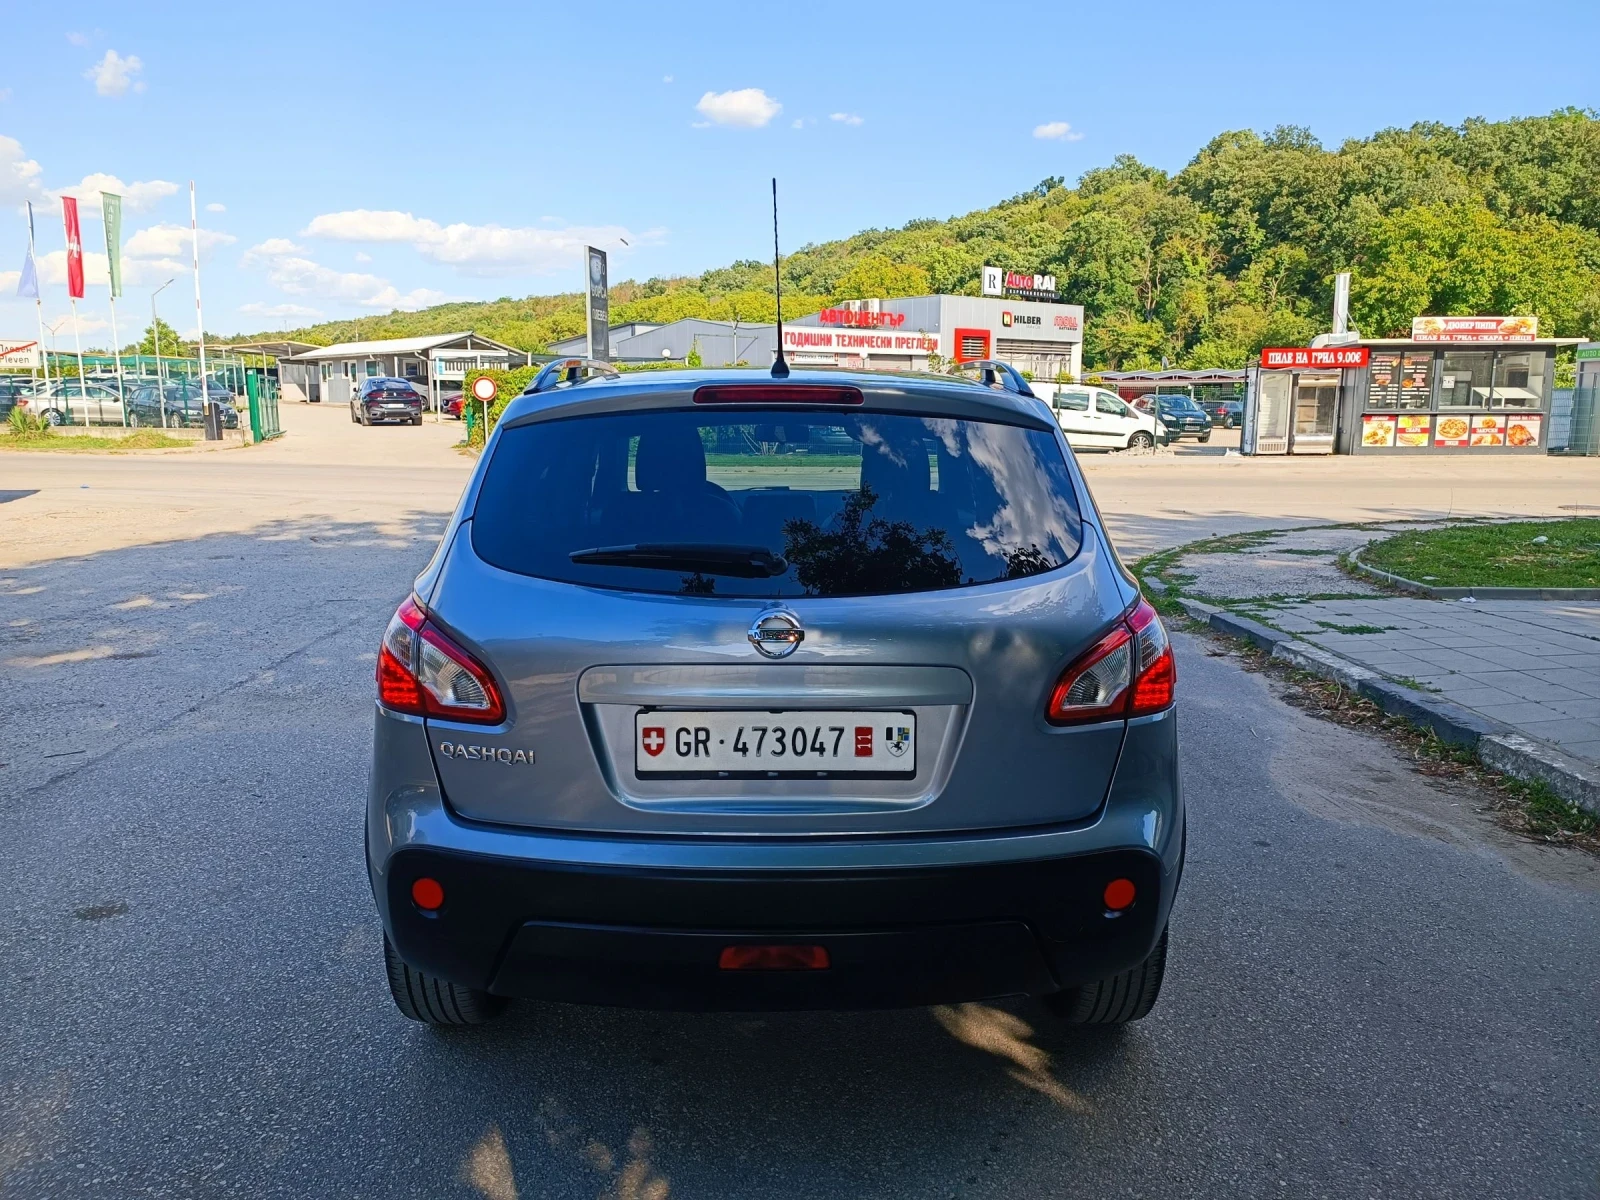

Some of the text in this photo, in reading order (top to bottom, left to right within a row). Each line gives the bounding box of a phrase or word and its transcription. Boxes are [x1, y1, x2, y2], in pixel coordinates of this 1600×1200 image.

[988, 273, 996, 289] R
[819, 308, 905, 327] АВТОЦЕНТЪР
[1013, 315, 1042, 325] HILBER
[784, 331, 938, 351] ГОДИШНИ ТЕХНИЧЕСКИ ПРЕГЛЕДИ
[1268, 351, 1362, 364] ПИЛЕ НА ГРИЛ 9.00€
[675, 726, 711, 757] GR
[732, 726, 845, 757] 473047
[440, 741, 535, 765] QASHQAI
